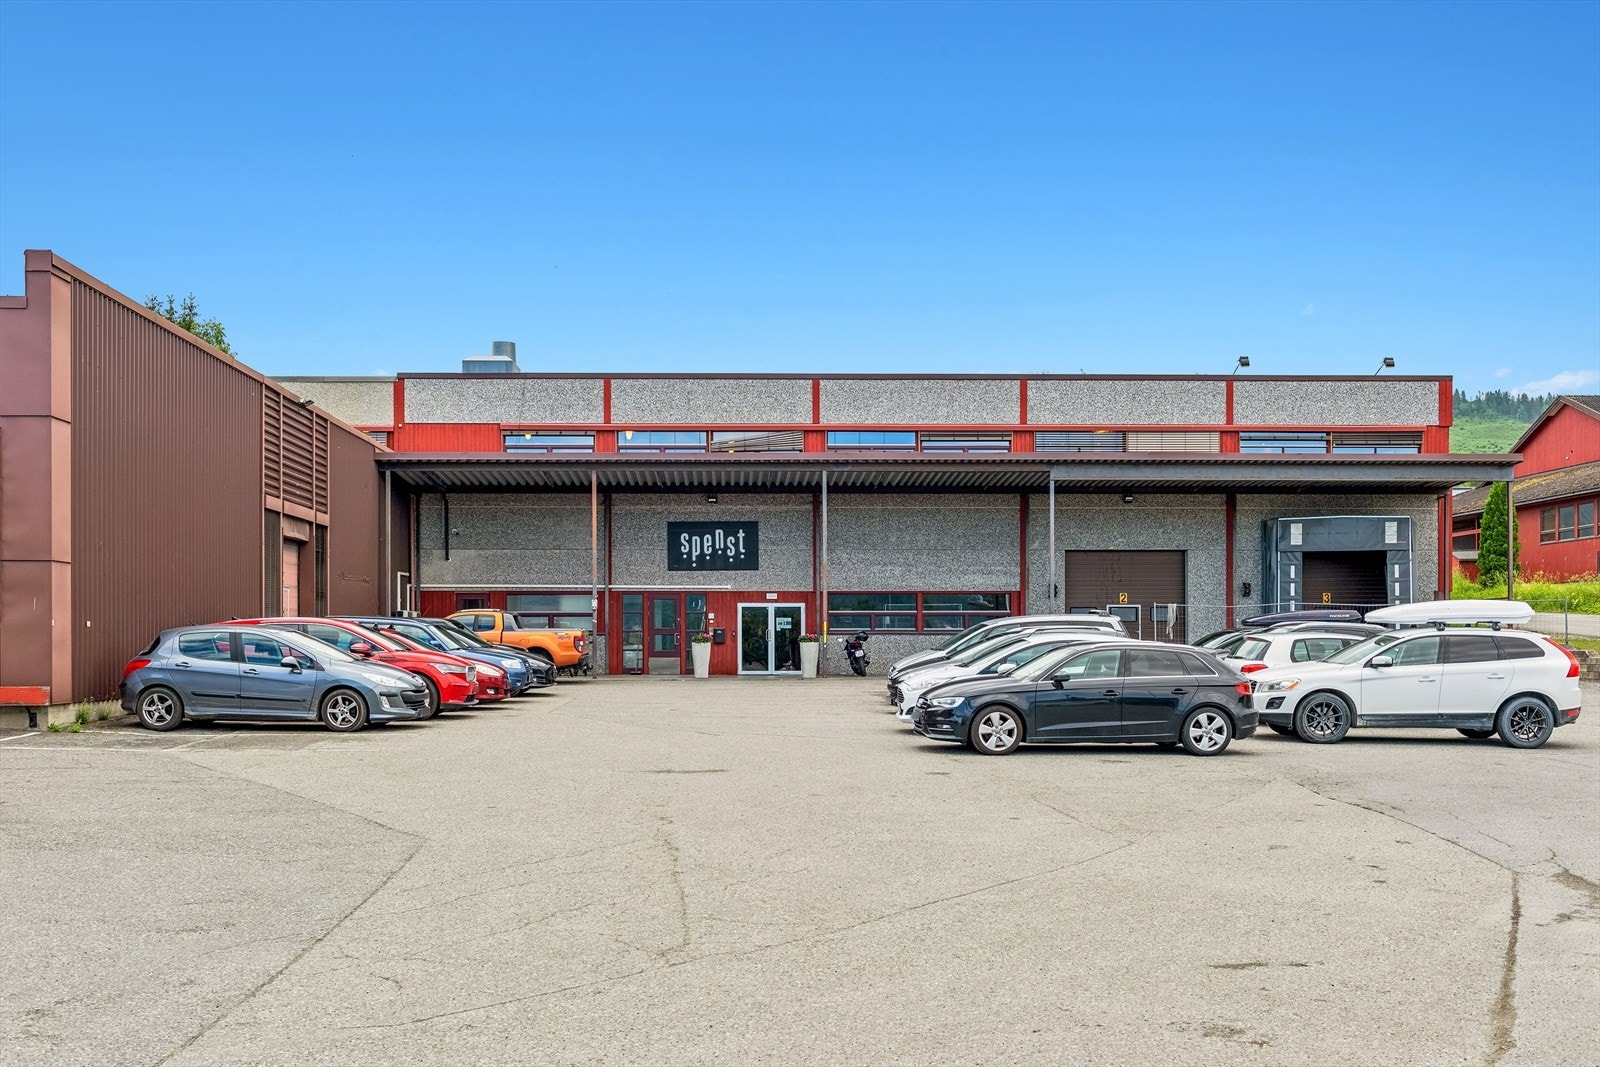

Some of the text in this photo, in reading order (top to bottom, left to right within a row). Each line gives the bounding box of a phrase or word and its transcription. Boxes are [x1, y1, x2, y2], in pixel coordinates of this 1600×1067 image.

[681, 529, 745, 562] spenst
[1120, 593, 1127, 603] 2
[1323, 593, 1330, 603] 3
